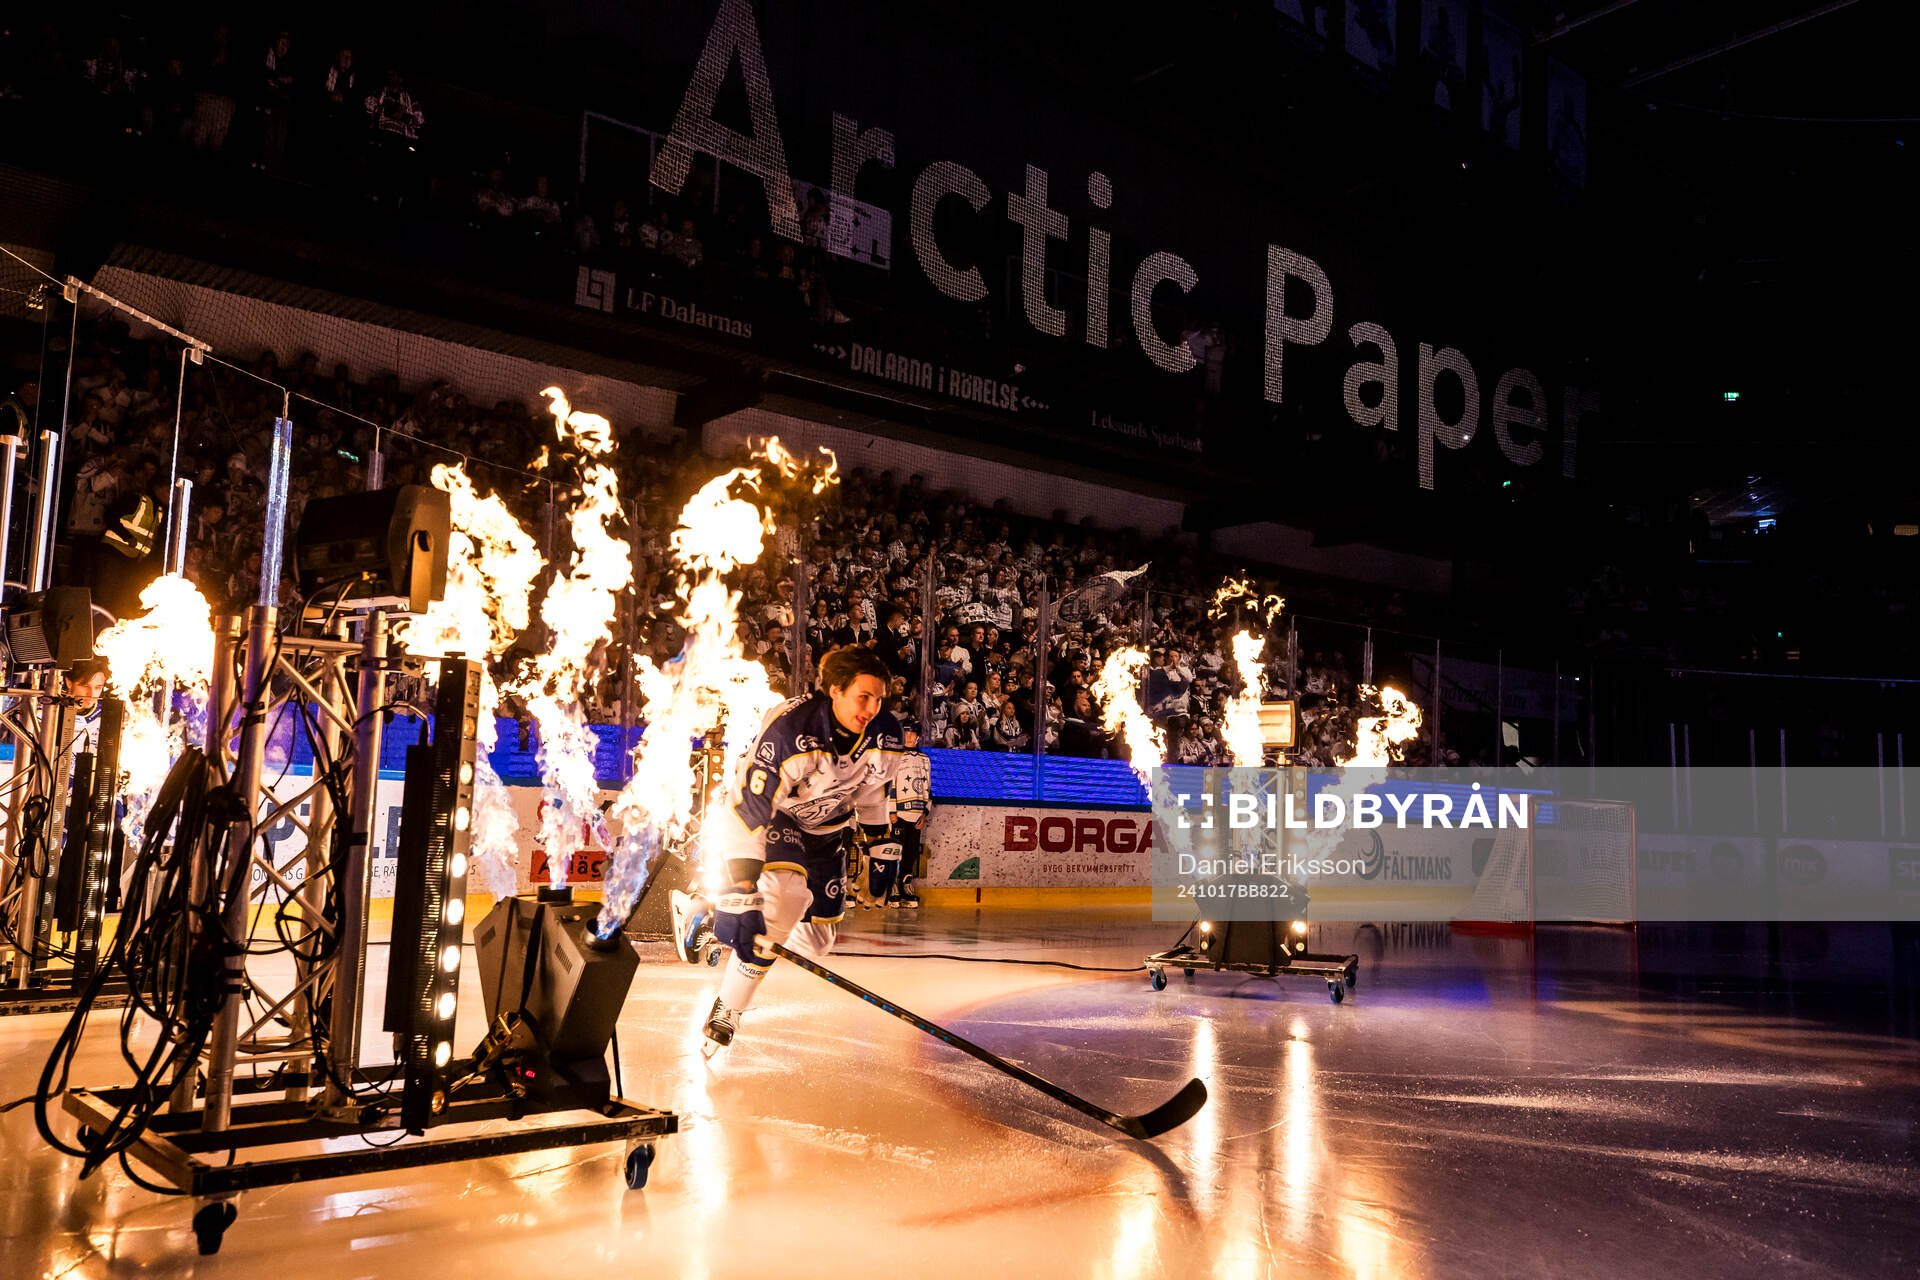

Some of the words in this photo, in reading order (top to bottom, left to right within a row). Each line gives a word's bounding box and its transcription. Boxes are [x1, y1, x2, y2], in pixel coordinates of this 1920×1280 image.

[648, 0, 1200, 374] Arctic
[1264, 242, 1601, 491] Paper
[626, 287, 655, 312] LF
[660, 296, 753, 339] Dalarnas
[850, 342, 932, 390] DALARNA
[949, 369, 1020, 412] RÖRELSE
[1004, 815, 1169, 854] BORGA
[1043, 864, 1063, 874] BYGG
[1382, 850, 1452, 881] FÄLTMANS
